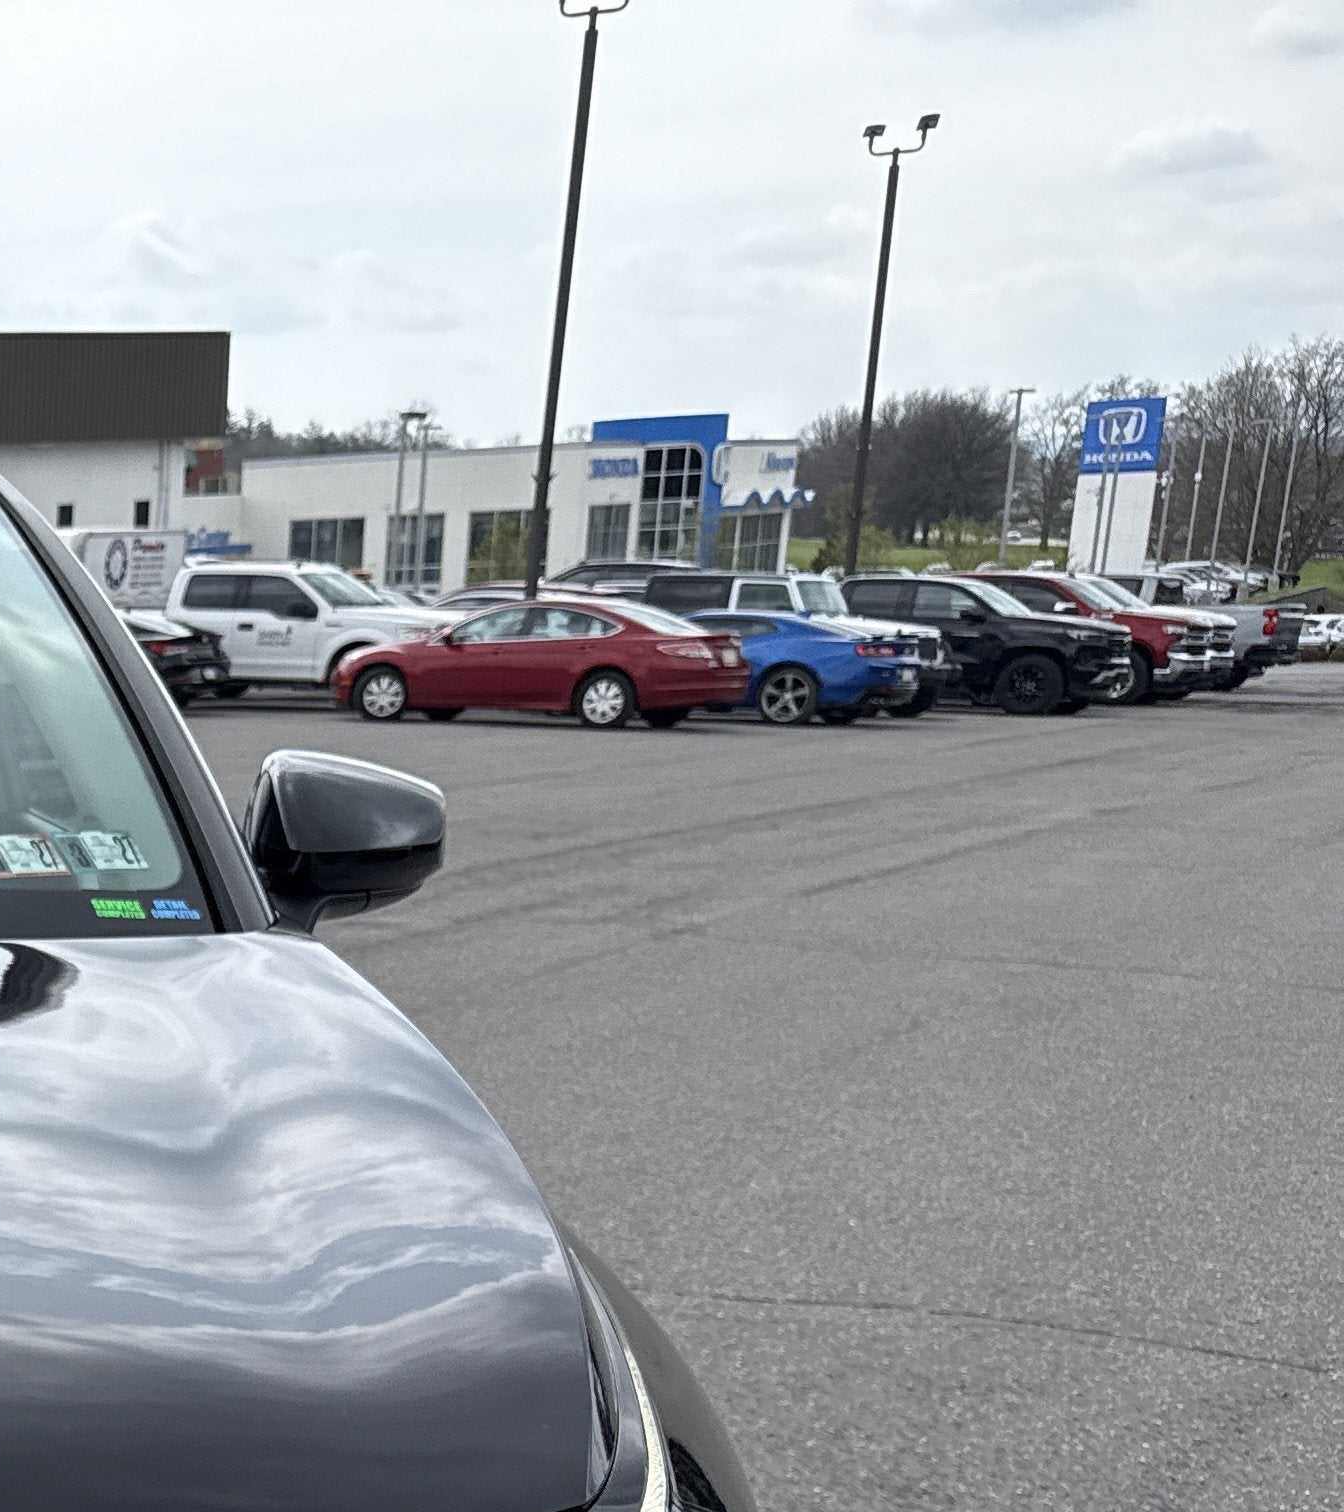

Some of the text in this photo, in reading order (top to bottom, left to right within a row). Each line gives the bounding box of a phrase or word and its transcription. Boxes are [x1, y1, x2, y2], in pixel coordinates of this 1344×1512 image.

[29, 839, 60, 870] 27
[67, 836, 144, 868] 3 27
